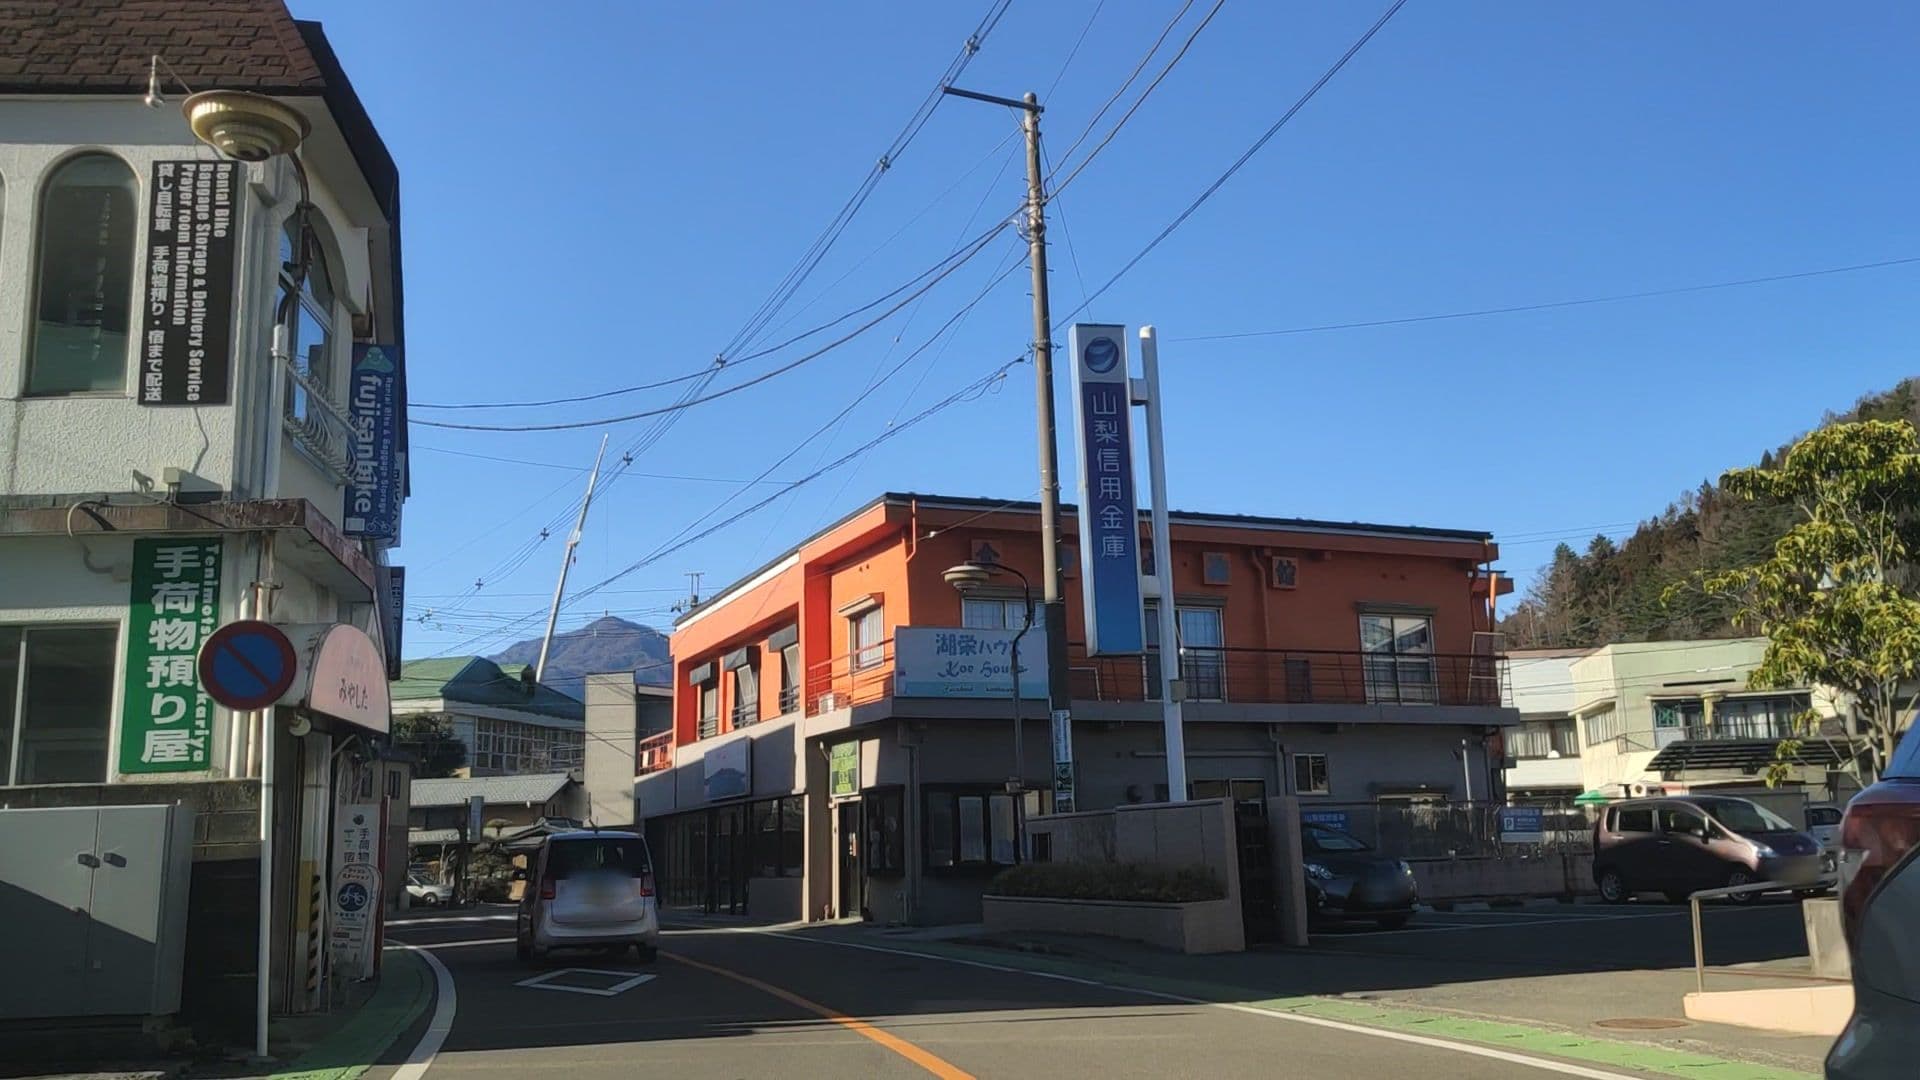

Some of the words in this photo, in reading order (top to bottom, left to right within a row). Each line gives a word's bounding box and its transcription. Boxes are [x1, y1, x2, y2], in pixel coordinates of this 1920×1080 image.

[178, 164, 196, 205] Prayer
[197, 164, 214, 220] Baggage
[215, 164, 231, 204] Rental
[177, 210, 191, 242] room
[213, 209, 229, 238] Bike
[193, 224, 211, 275] Storage
[172, 246, 191, 326] Information
[194, 279, 206, 287] &
[188, 291, 208, 346] Delivery
[186, 350, 204, 401] Service
[384, 377, 393, 404] Rental
[354, 375, 383, 513] fujisanbike
[1092, 391, 1127, 559] 山梨信用金庫
[377, 480, 390, 514] Storage
[141, 546, 202, 764] 手荷物預り屋
[937, 660, 974, 678] Koe
[338, 677, 369, 711] みやした
